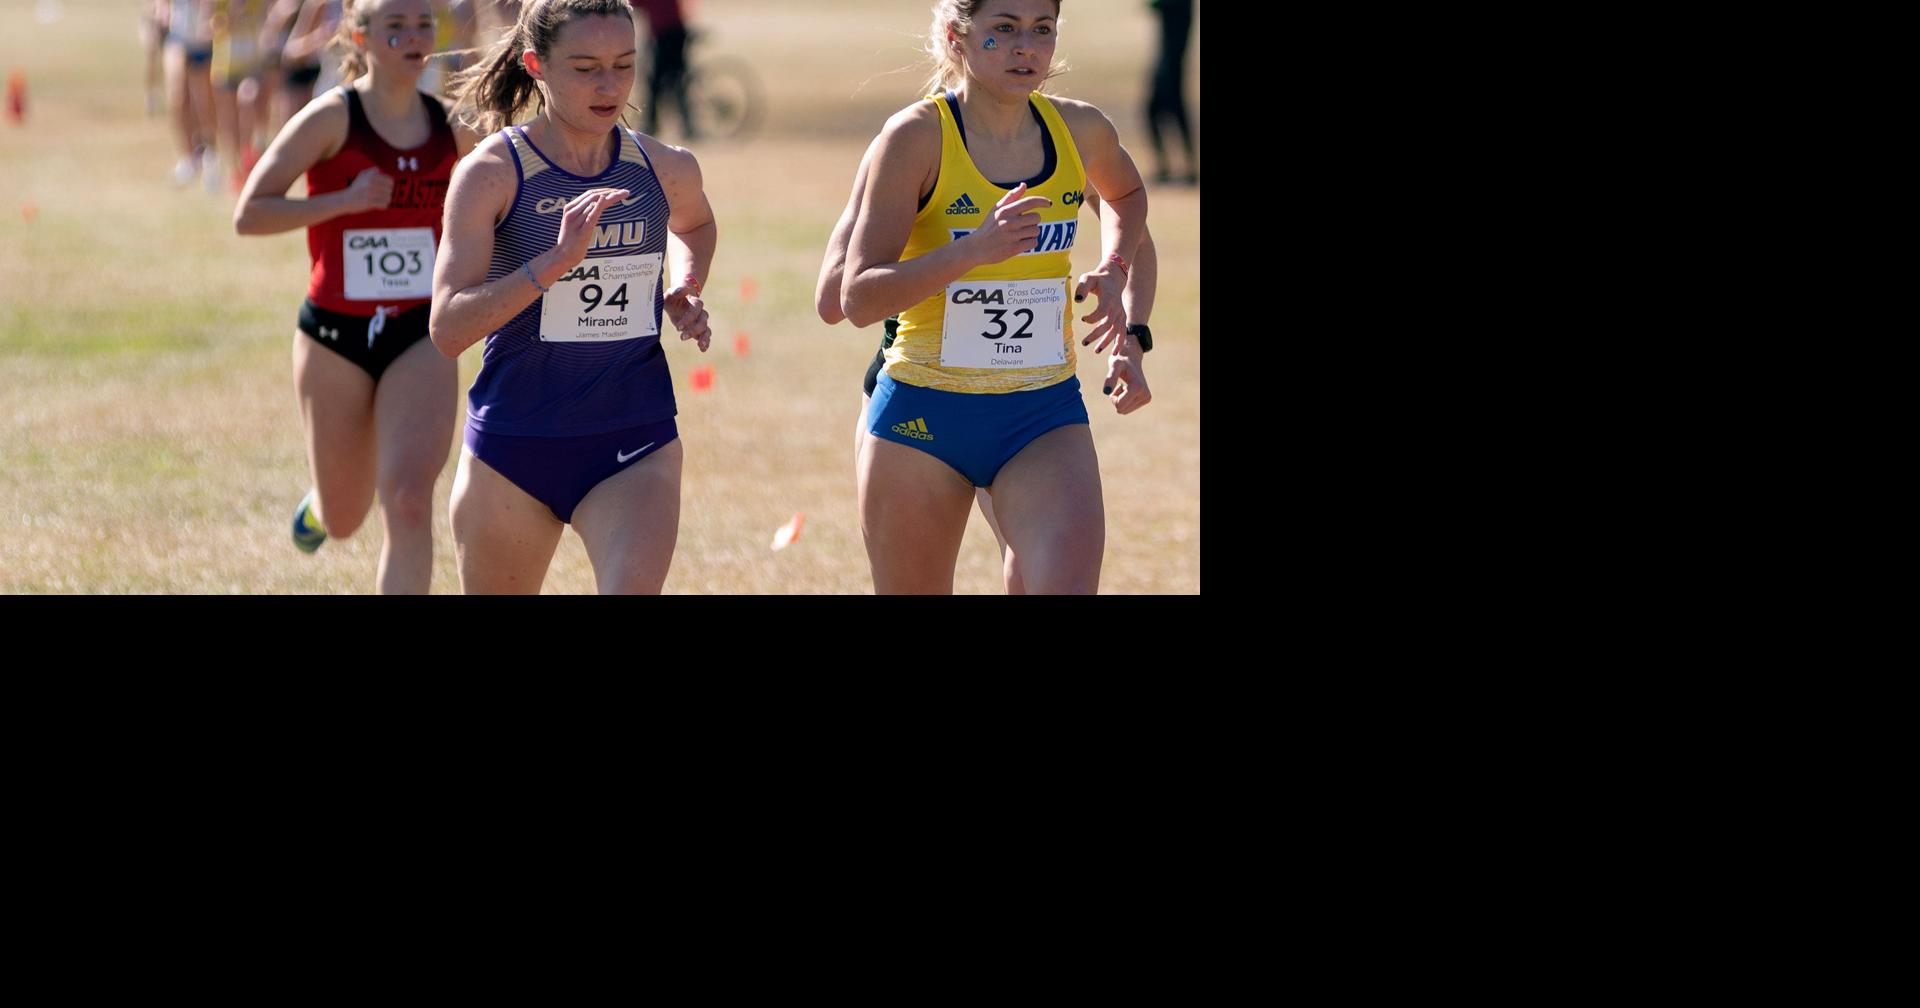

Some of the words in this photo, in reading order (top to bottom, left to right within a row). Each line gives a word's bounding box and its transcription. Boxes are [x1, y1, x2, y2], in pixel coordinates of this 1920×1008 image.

[1062, 190, 1080, 206] CA
[535, 196, 570, 214] CA
[945, 206, 980, 215] adidas
[588, 221, 645, 249] MU
[349, 236, 389, 250] CAA
[364, 251, 421, 276] 103
[626, 263, 654, 272] Country
[602, 270, 654, 281] Championships
[579, 283, 629, 313] 94
[951, 288, 1005, 305] CAA
[1007, 289, 1028, 297] Cross
[1030, 287, 1057, 296] Country
[1006, 295, 1059, 306] Championships
[577, 315, 628, 327] Miranda
[981, 308, 1034, 339] 32
[575, 331, 600, 339] James
[994, 342, 1022, 354] Tina
[990, 358, 1024, 366] Delaware
[891, 424, 934, 441] adidas
